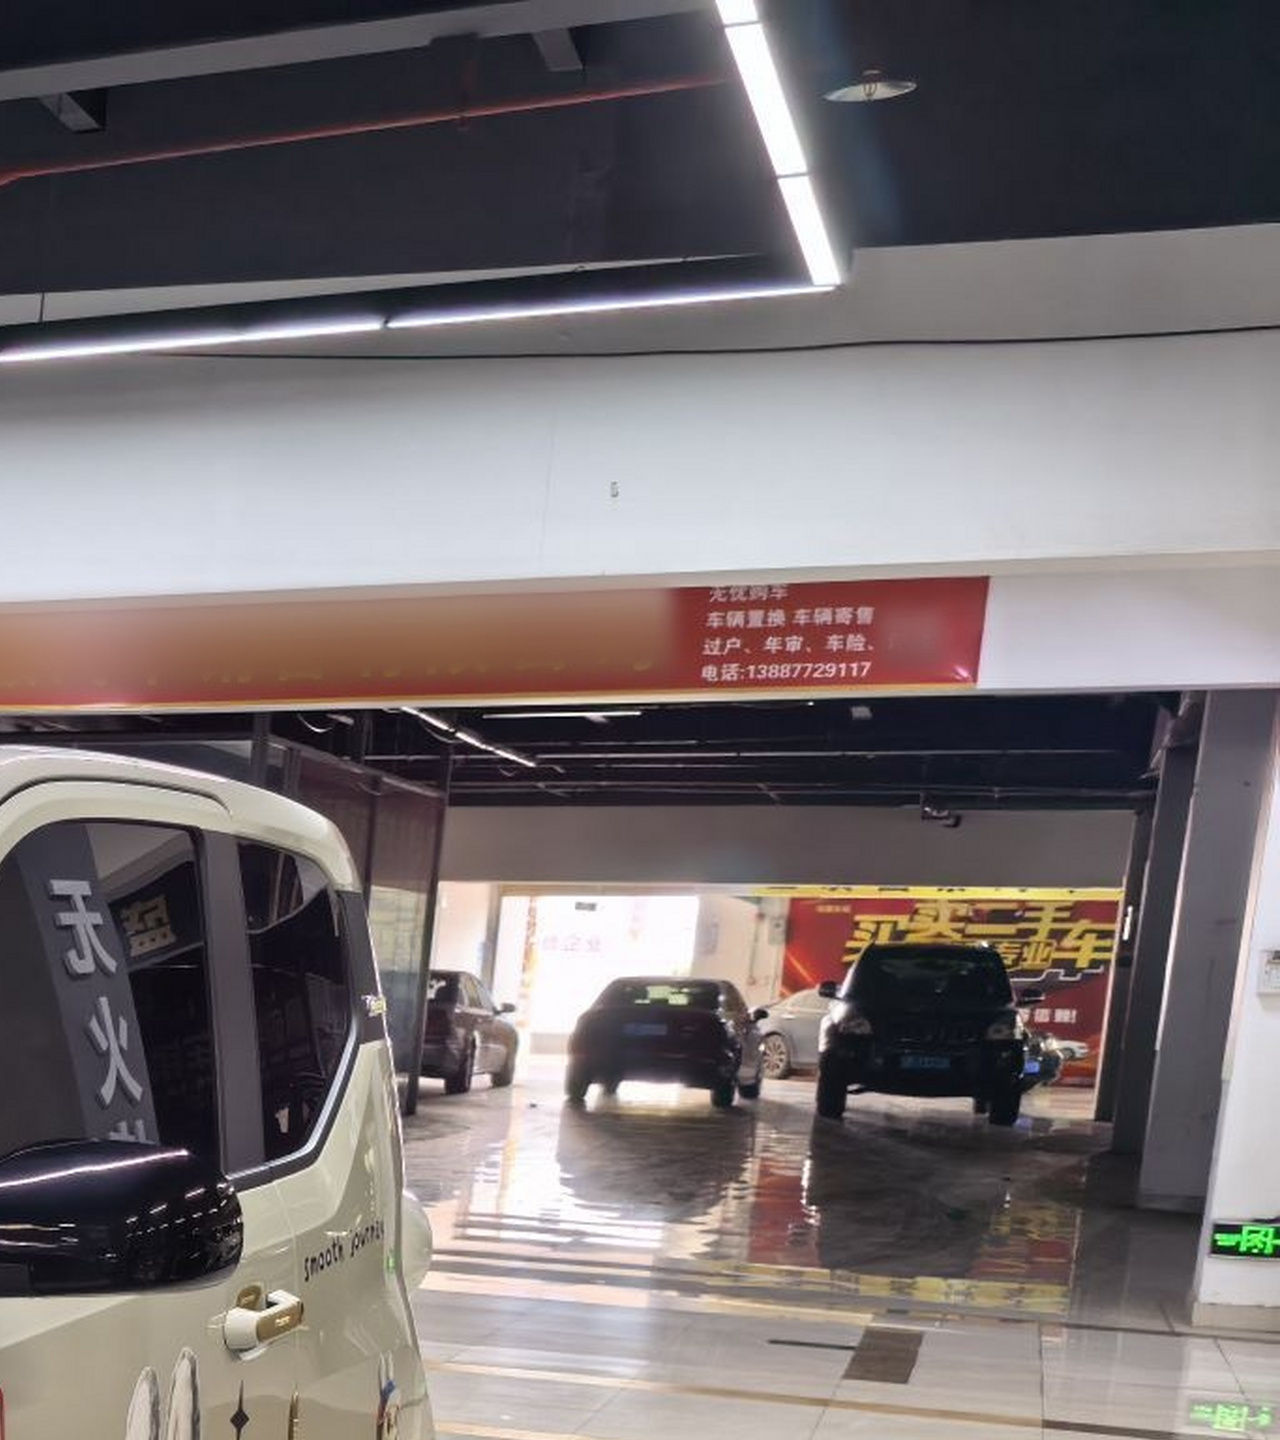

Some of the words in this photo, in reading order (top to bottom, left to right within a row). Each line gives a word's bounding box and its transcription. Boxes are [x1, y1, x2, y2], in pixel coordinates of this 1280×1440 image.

[705, 608, 787, 629] 车辆置换
[792, 606, 875, 626] 车辆寄售
